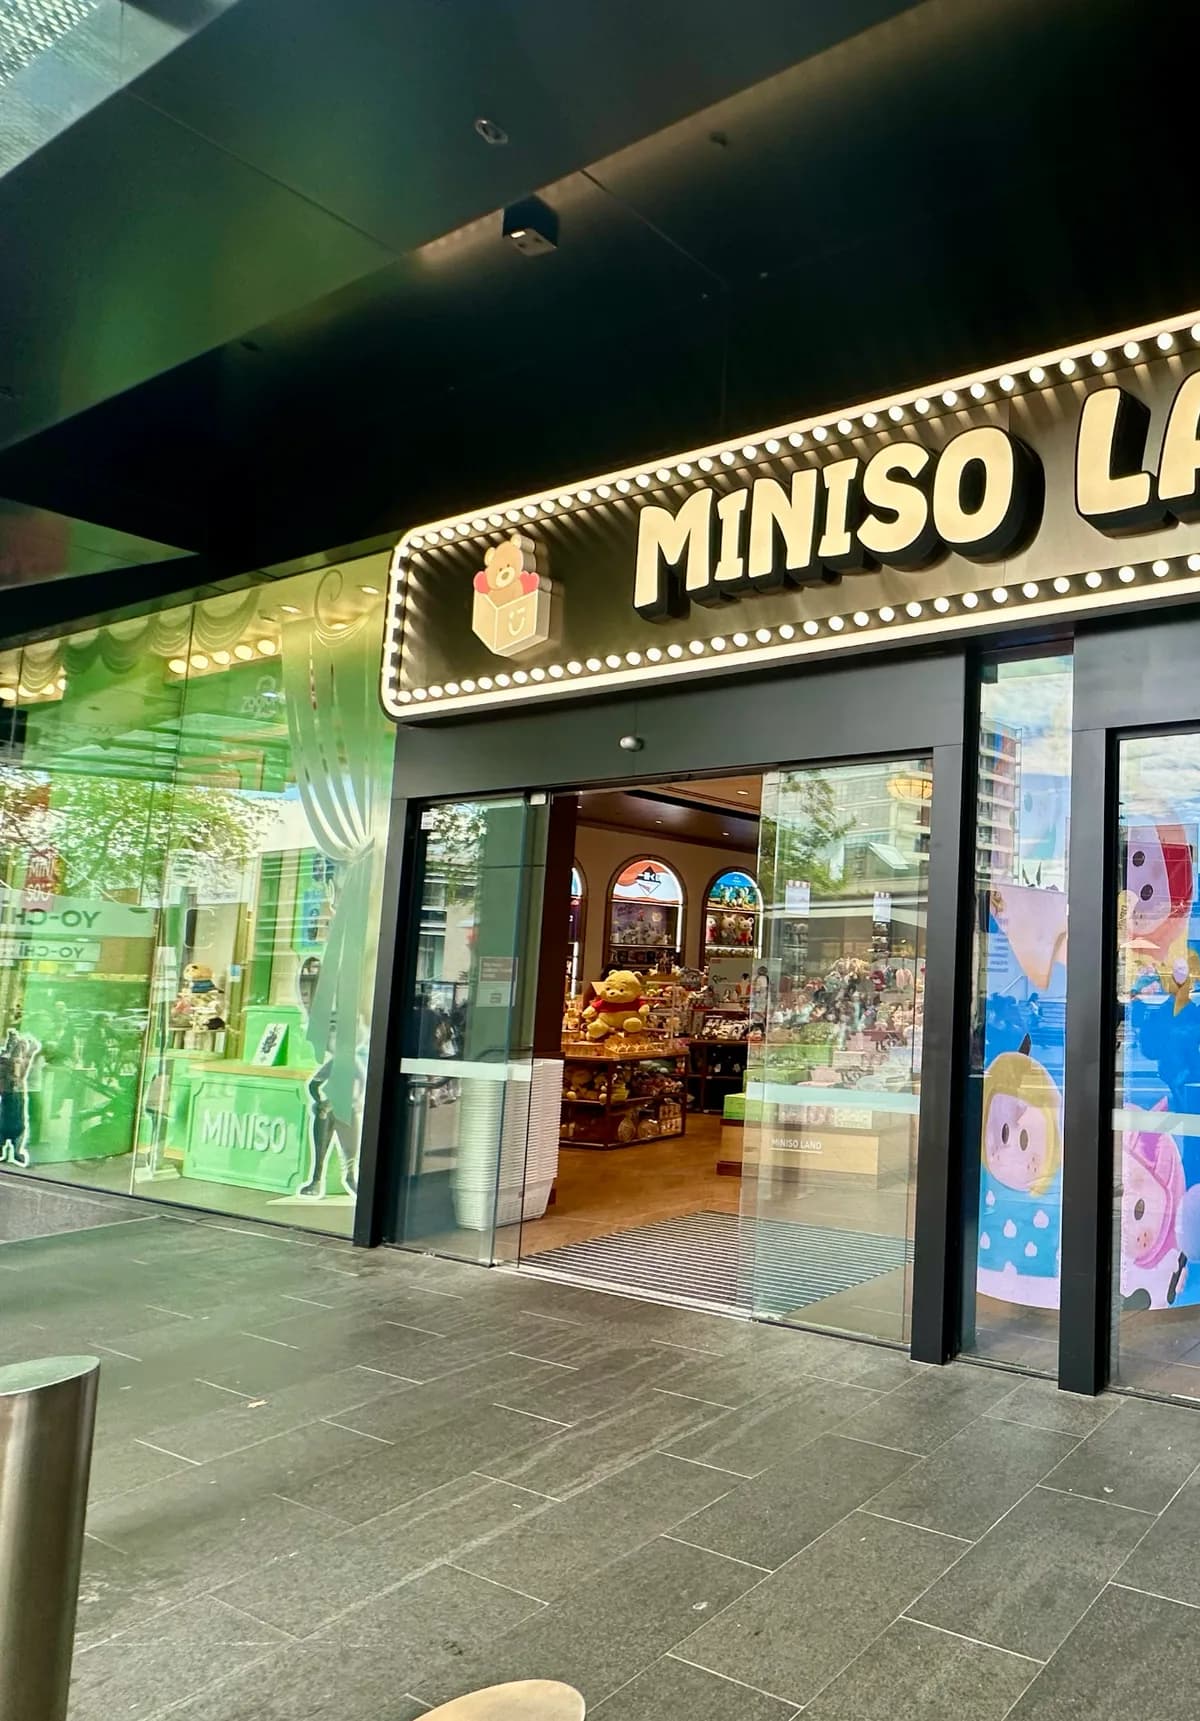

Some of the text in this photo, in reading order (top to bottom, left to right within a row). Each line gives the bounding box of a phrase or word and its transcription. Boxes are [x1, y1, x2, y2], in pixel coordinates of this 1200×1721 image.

[634, 425, 1014, 610] MINISO
[203, 1110, 288, 1154] MINISO
[771, 1137, 822, 1150] MINISO LAND
